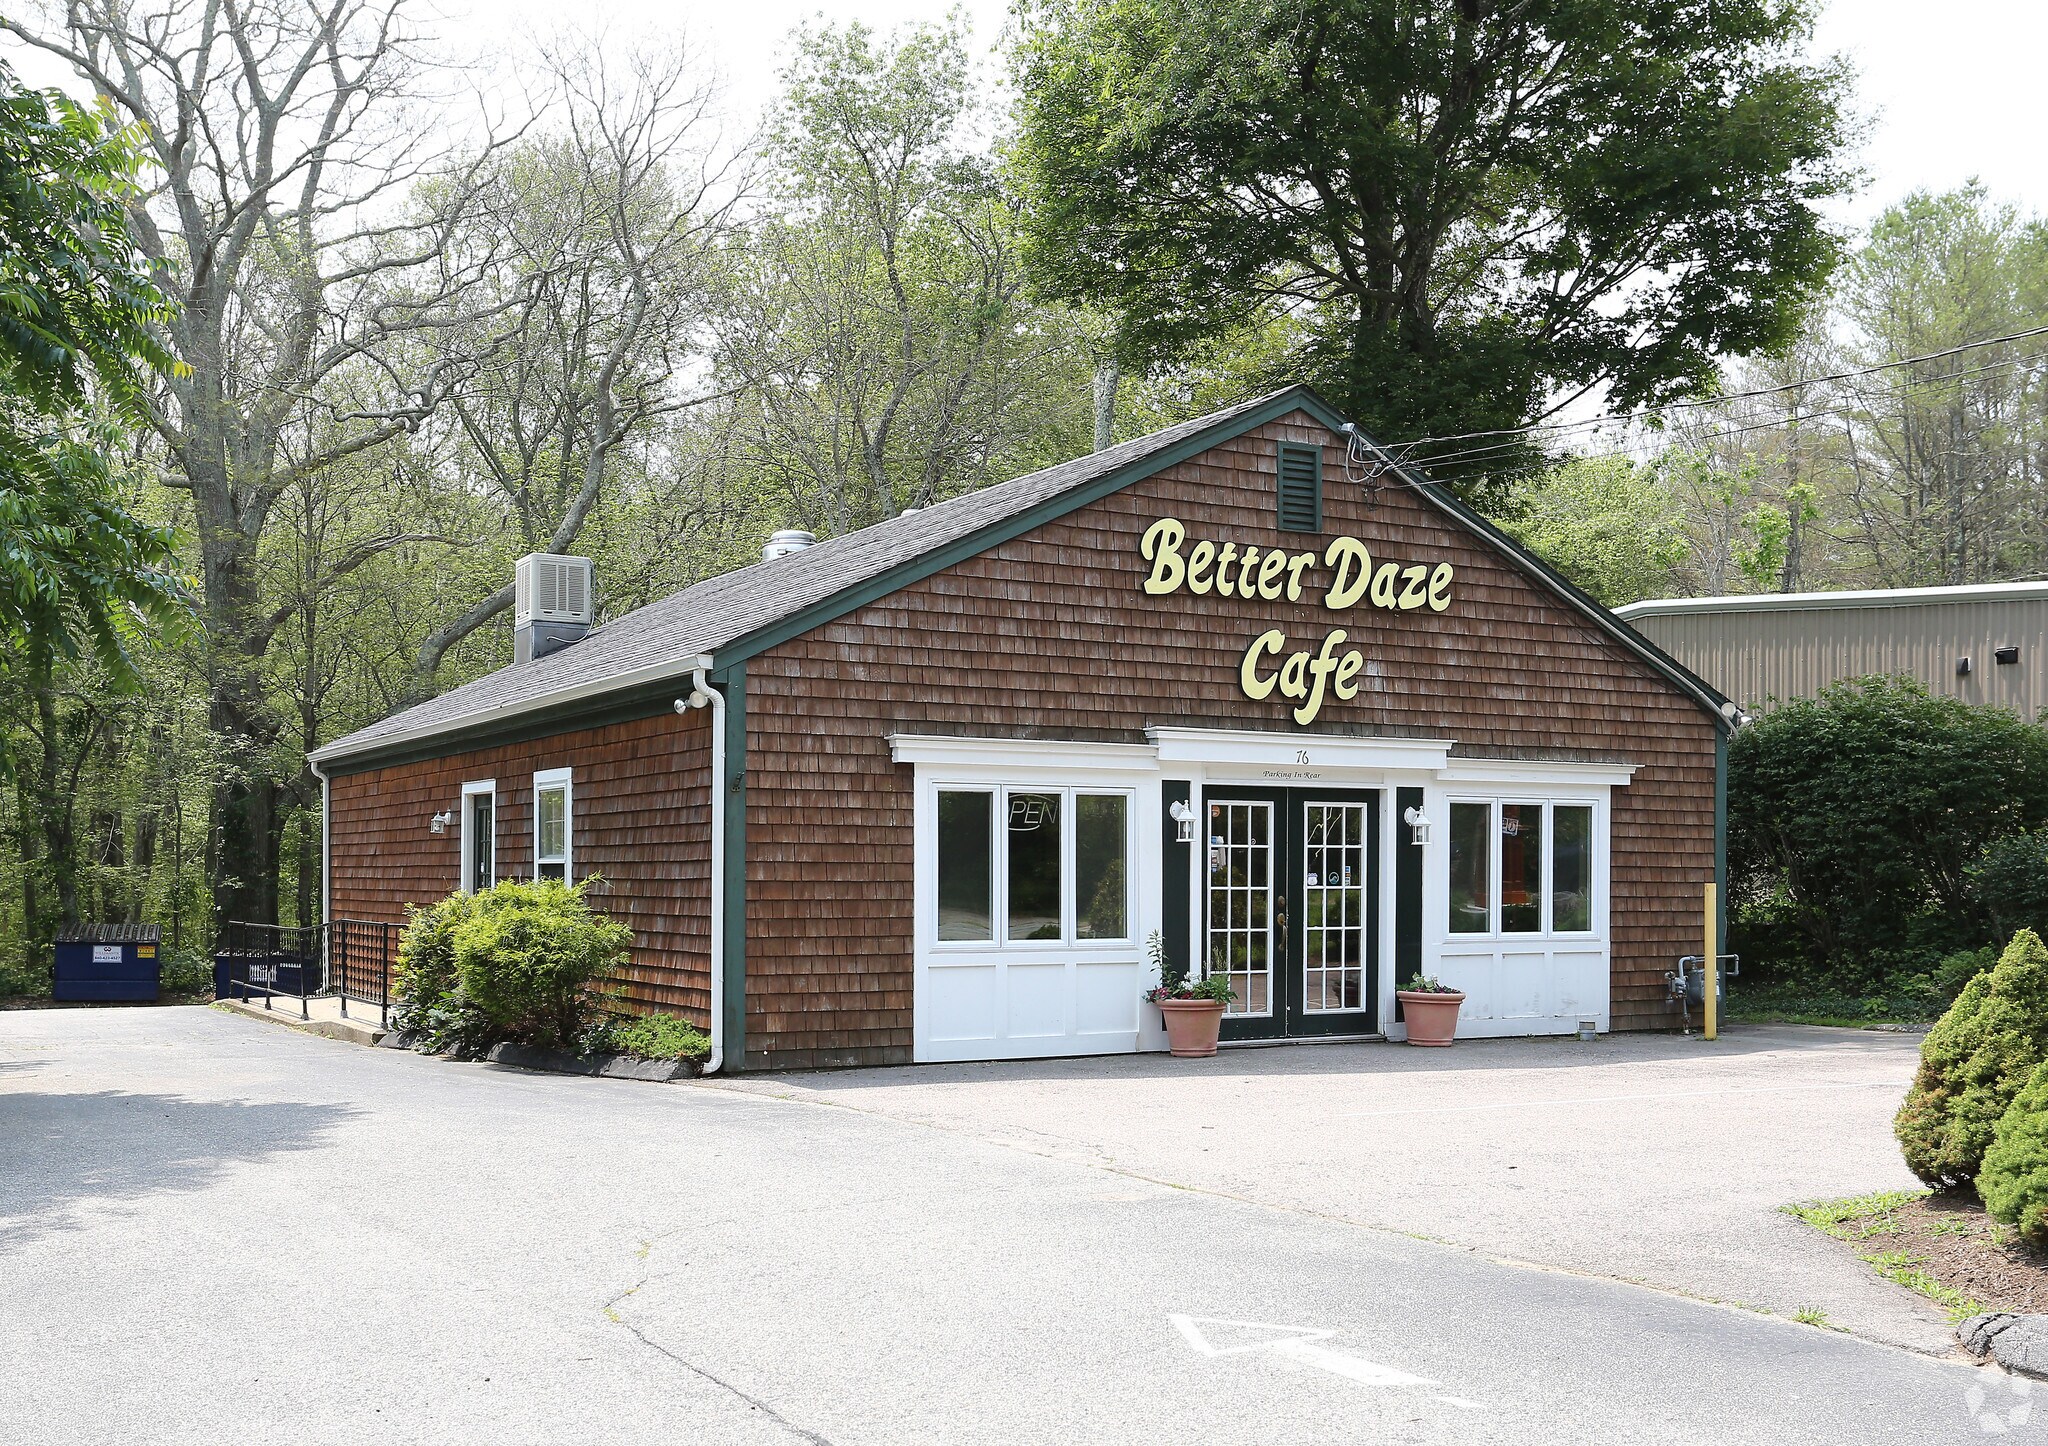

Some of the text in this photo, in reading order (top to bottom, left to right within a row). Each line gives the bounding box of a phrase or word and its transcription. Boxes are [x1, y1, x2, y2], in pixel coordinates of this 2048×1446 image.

[1140, 517, 1454, 612] Better Daze
[1240, 629, 1364, 726] Cafe
[1296, 749, 1310, 765] 76
[1262, 770, 1292, 780] Parking
[1303, 771, 1321, 779] Rear
[1008, 800, 1059, 824] PEN
